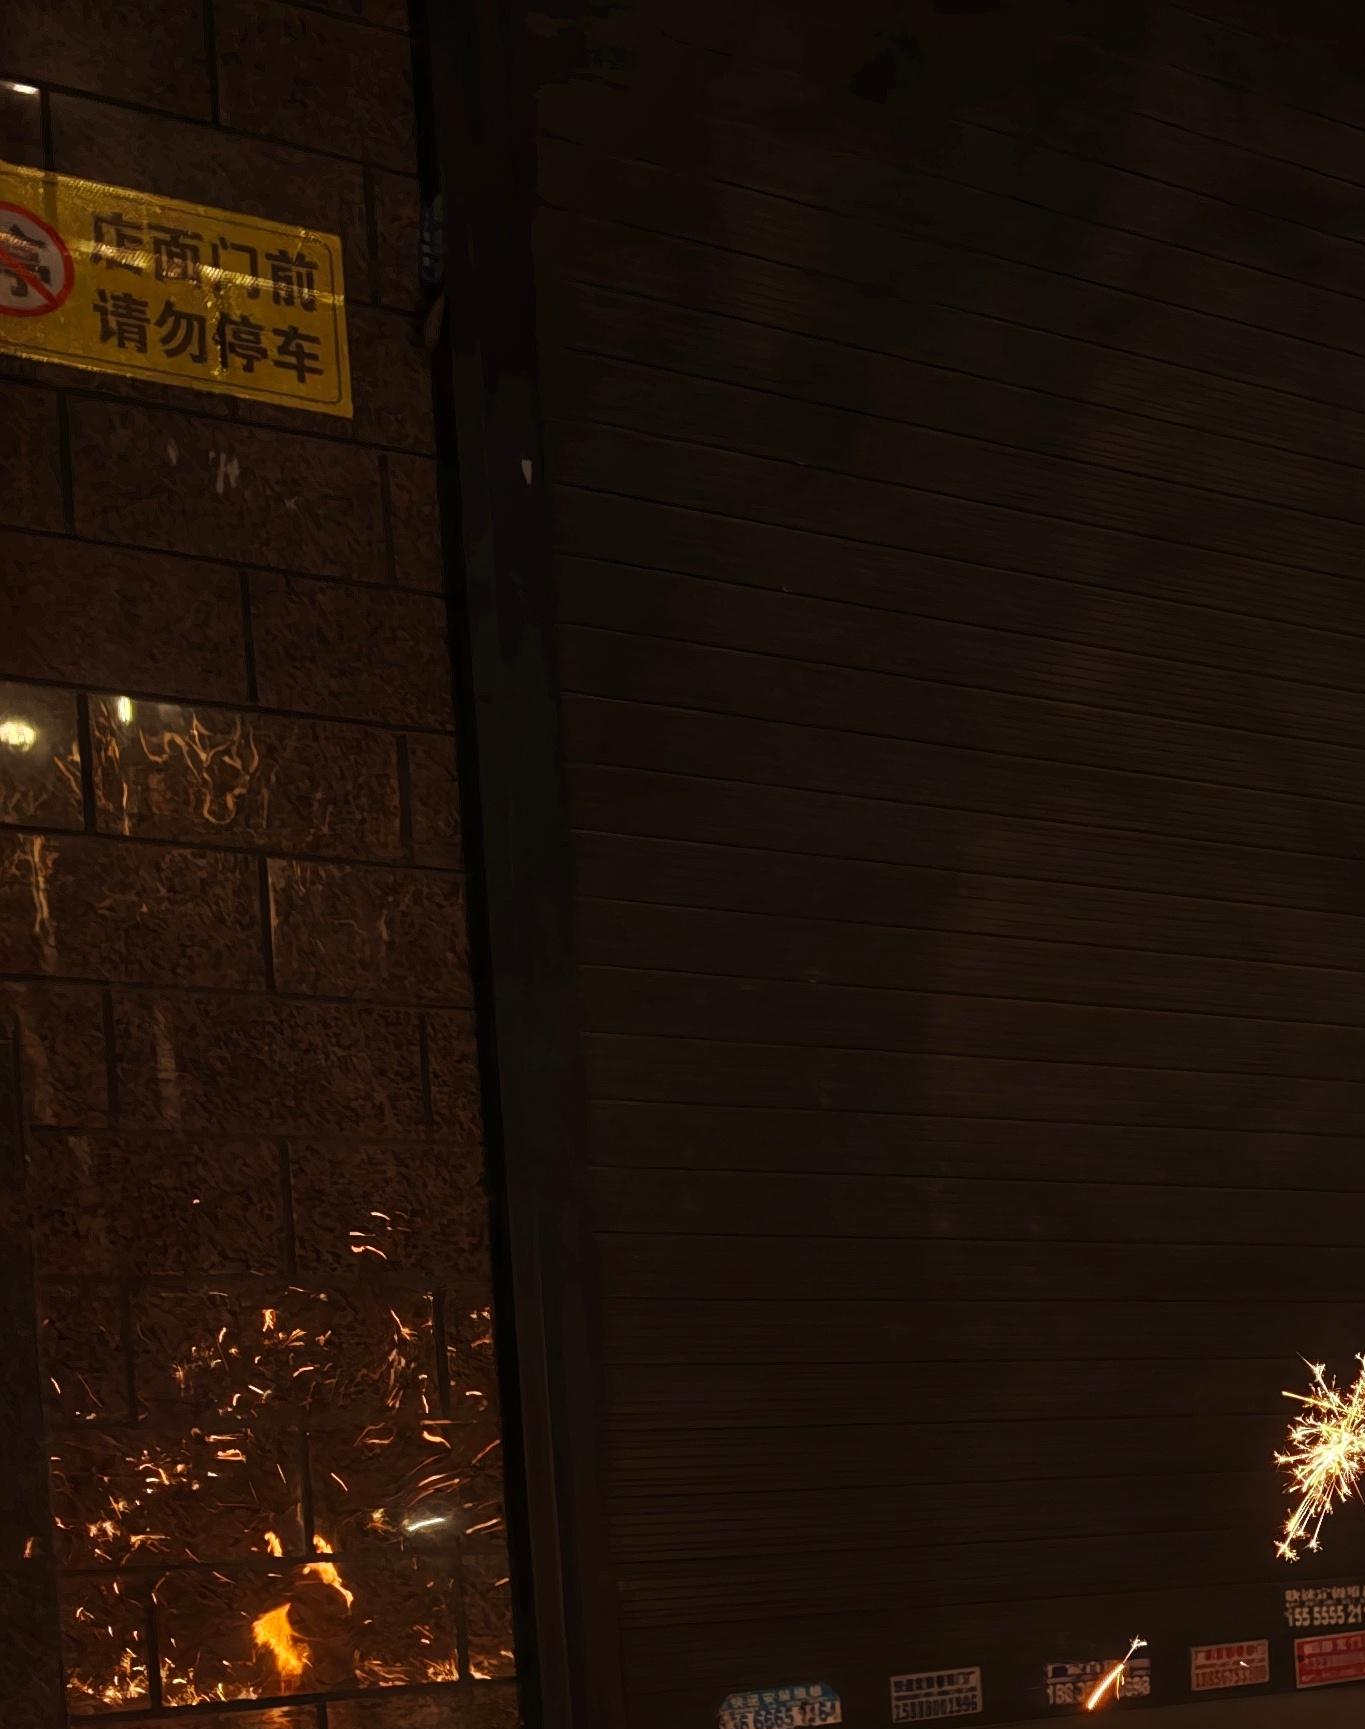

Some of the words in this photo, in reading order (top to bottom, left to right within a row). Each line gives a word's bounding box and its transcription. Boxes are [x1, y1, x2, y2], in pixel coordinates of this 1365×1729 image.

[90, 212, 319, 312] 店面门前
[92, 288, 323, 382] 请勿停车
